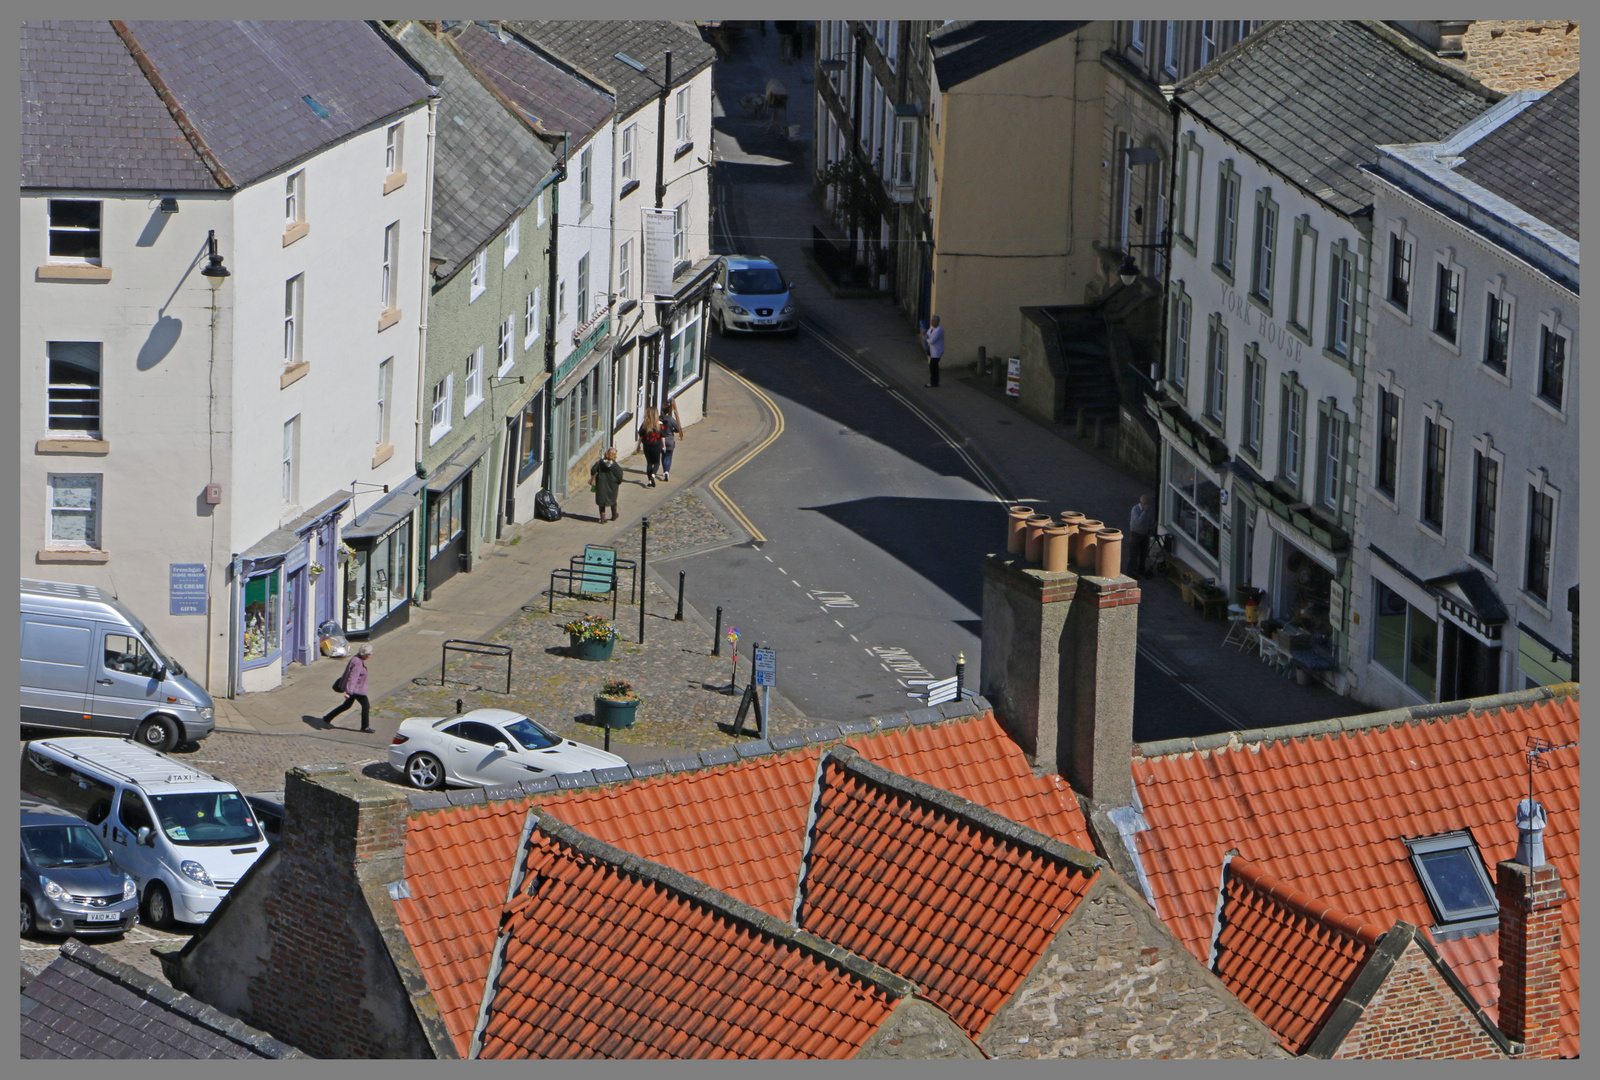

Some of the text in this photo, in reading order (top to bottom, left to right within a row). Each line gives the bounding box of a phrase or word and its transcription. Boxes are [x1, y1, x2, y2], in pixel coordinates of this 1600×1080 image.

[1221, 282, 1303, 364] YORK HOUSE
[810, 589, 935, 679] LOADING ONLY
